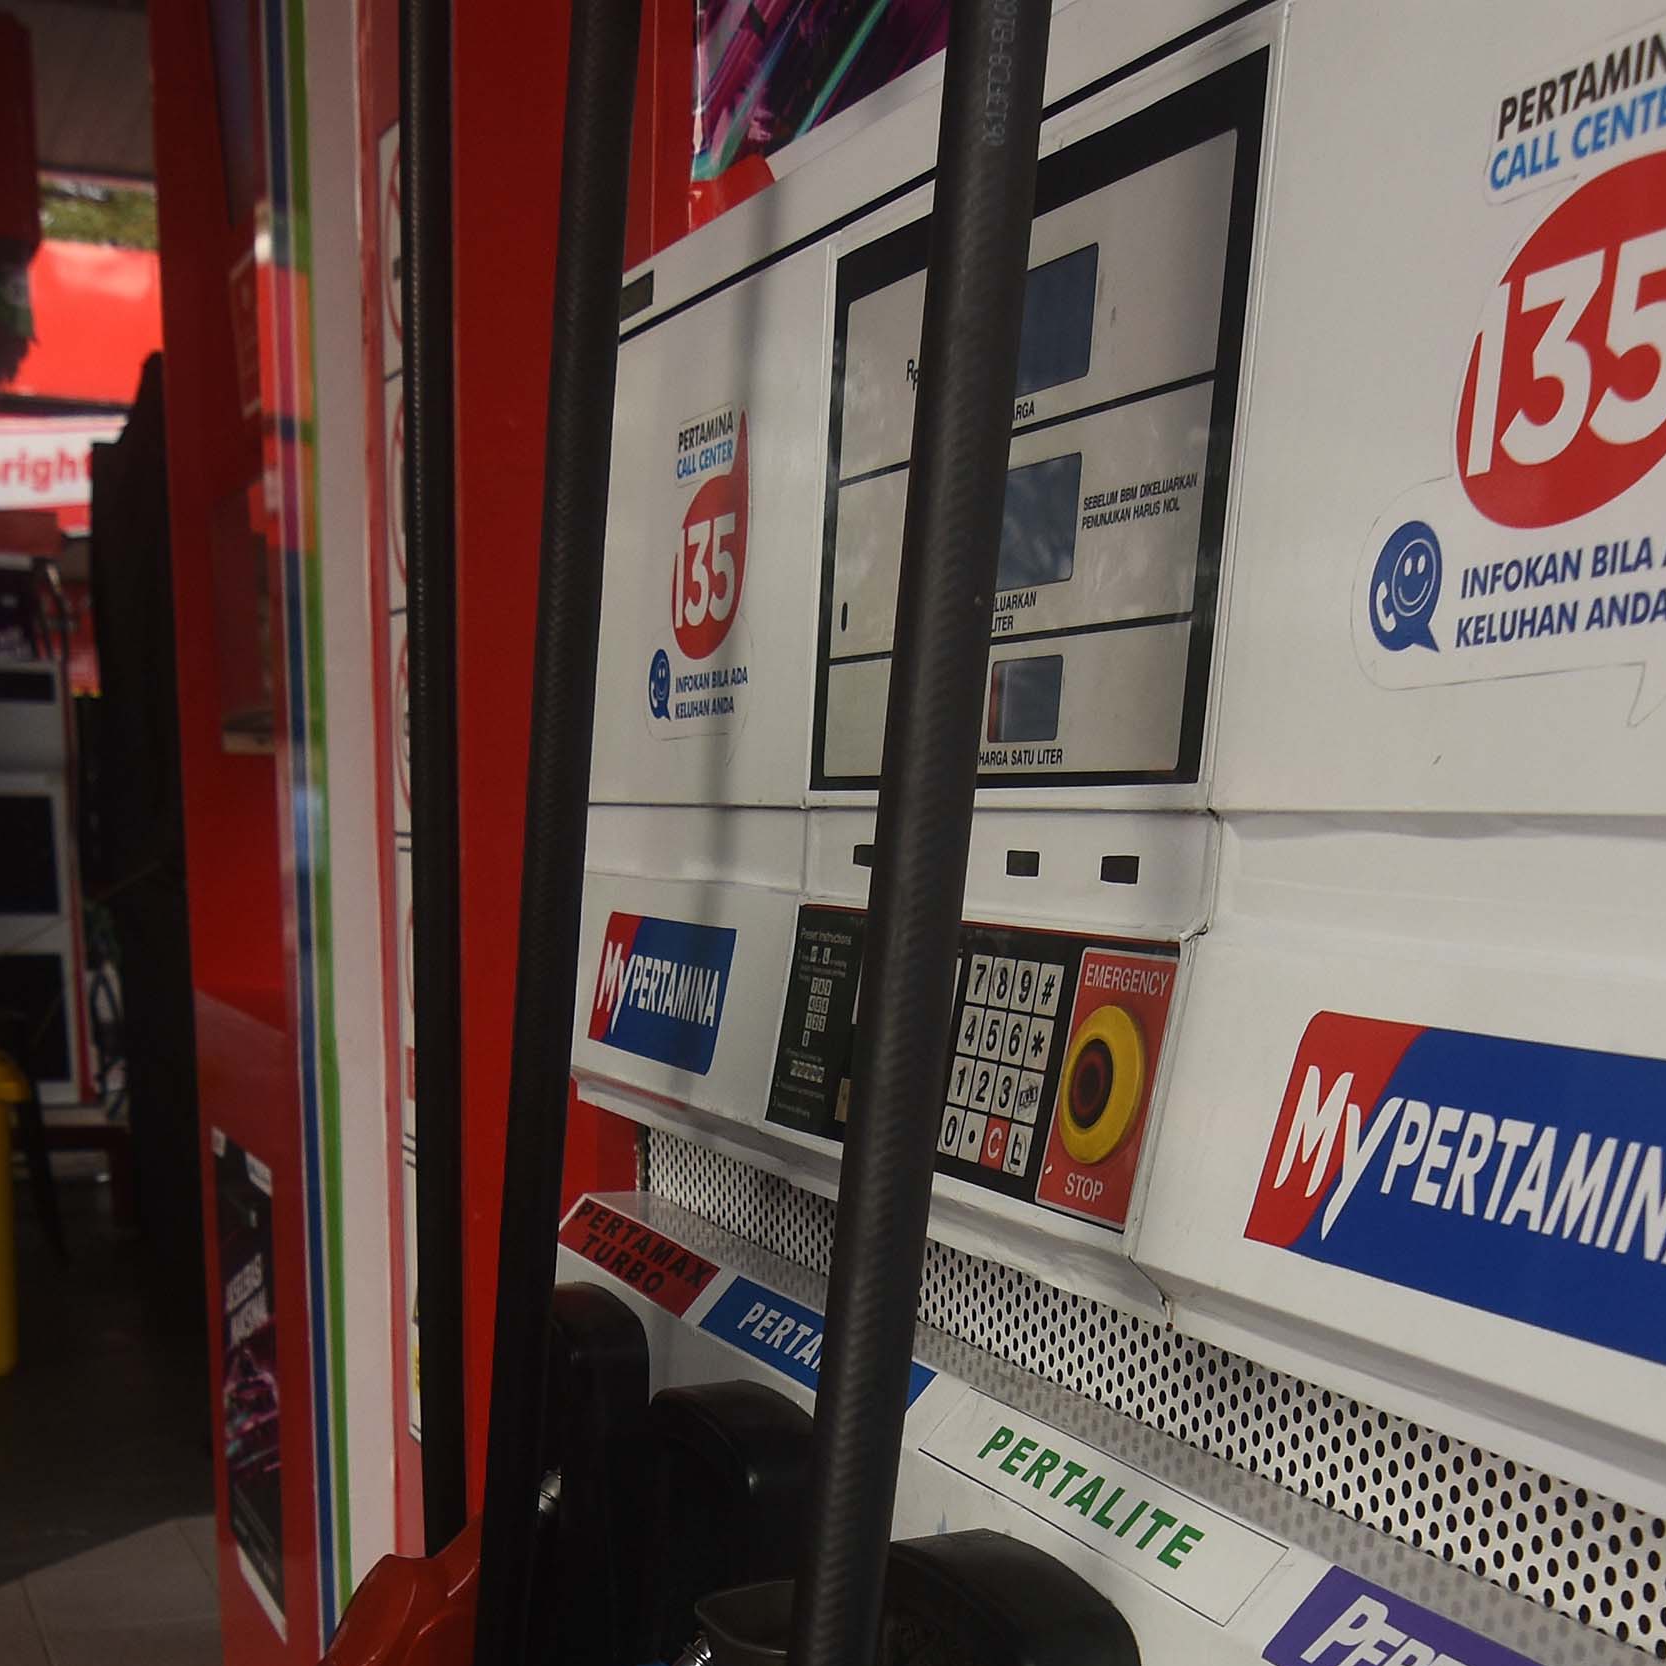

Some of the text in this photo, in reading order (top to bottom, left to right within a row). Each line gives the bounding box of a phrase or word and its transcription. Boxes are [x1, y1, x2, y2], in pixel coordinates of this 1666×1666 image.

[1490, 136, 1560, 191] CALL
[678, 411, 734, 453] PERTAMINA
[676, 440, 733, 479] CALL CENTER
[1082, 496, 1180, 530] PENUNJUKAN HARUS NOL
[1083, 472, 1198, 512] SEBELUM BBM DIKELUARKAN
[676, 512, 735, 629] 135
[1460, 548, 1582, 600] INFOKAN
[1590, 536, 1653, 580] BILA
[1455, 599, 1579, 648] KELUHAN
[675, 667, 748, 693] INFOKAN BILA ADA
[675, 697, 735, 720] KELUHAN ANDA
[978, 748, 1063, 767] HARGA SATU LITER
[974, 964, 987, 996] 7
[996, 967, 1008, 1000] 8
[1019, 970, 1032, 1004] 9
[1084, 963, 1169, 997] EMERGENCY
[964, 1016, 1022, 1056] 4 5 6
[956, 1067, 1012, 1109] 1 2 3
[944, 1115, 957, 1147] 0
[987, 1127, 1002, 1159] C
[1065, 1173, 1103, 1203] STOP
[574, 1202, 715, 1288] PERTAMAX
[582, 1234, 664, 1294] TURBO
[737, 1302, 823, 1372] PERTA
[977, 1426, 1205, 1570] PERTALITE
